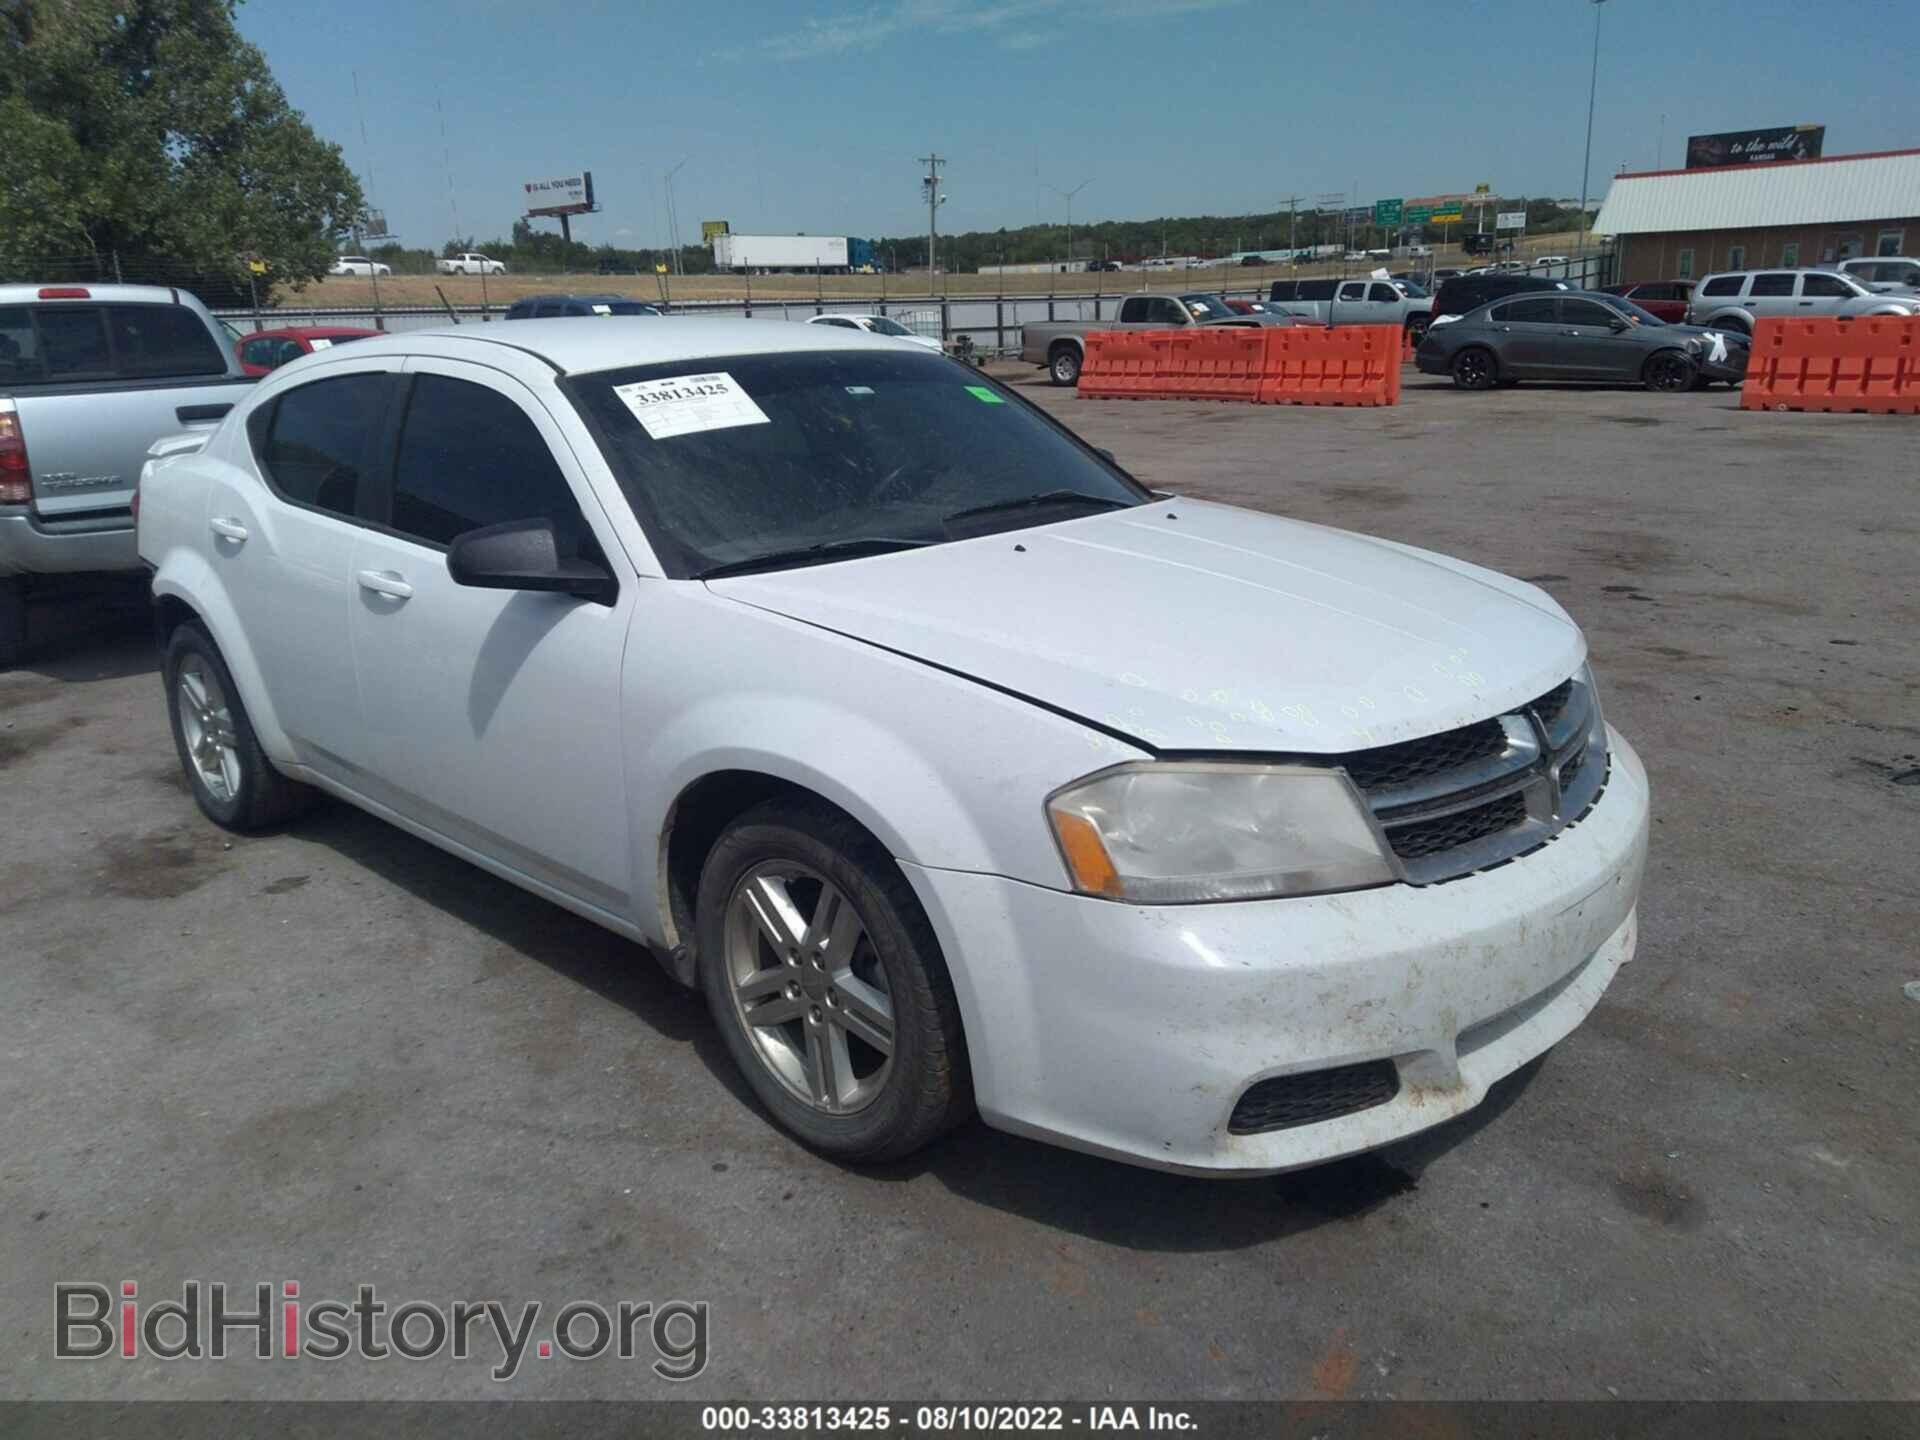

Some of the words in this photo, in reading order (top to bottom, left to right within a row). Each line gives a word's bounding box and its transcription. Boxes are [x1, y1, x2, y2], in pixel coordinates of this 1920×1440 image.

[1730, 143, 1743, 153] to
[1745, 137, 1764, 153] the
[1767, 134, 1799, 150] wild
[540, 180, 550, 190] ALL
[552, 180, 564, 188] YOU
[565, 178, 581, 186] NEED
[635, 383, 729, 405] 33813425
